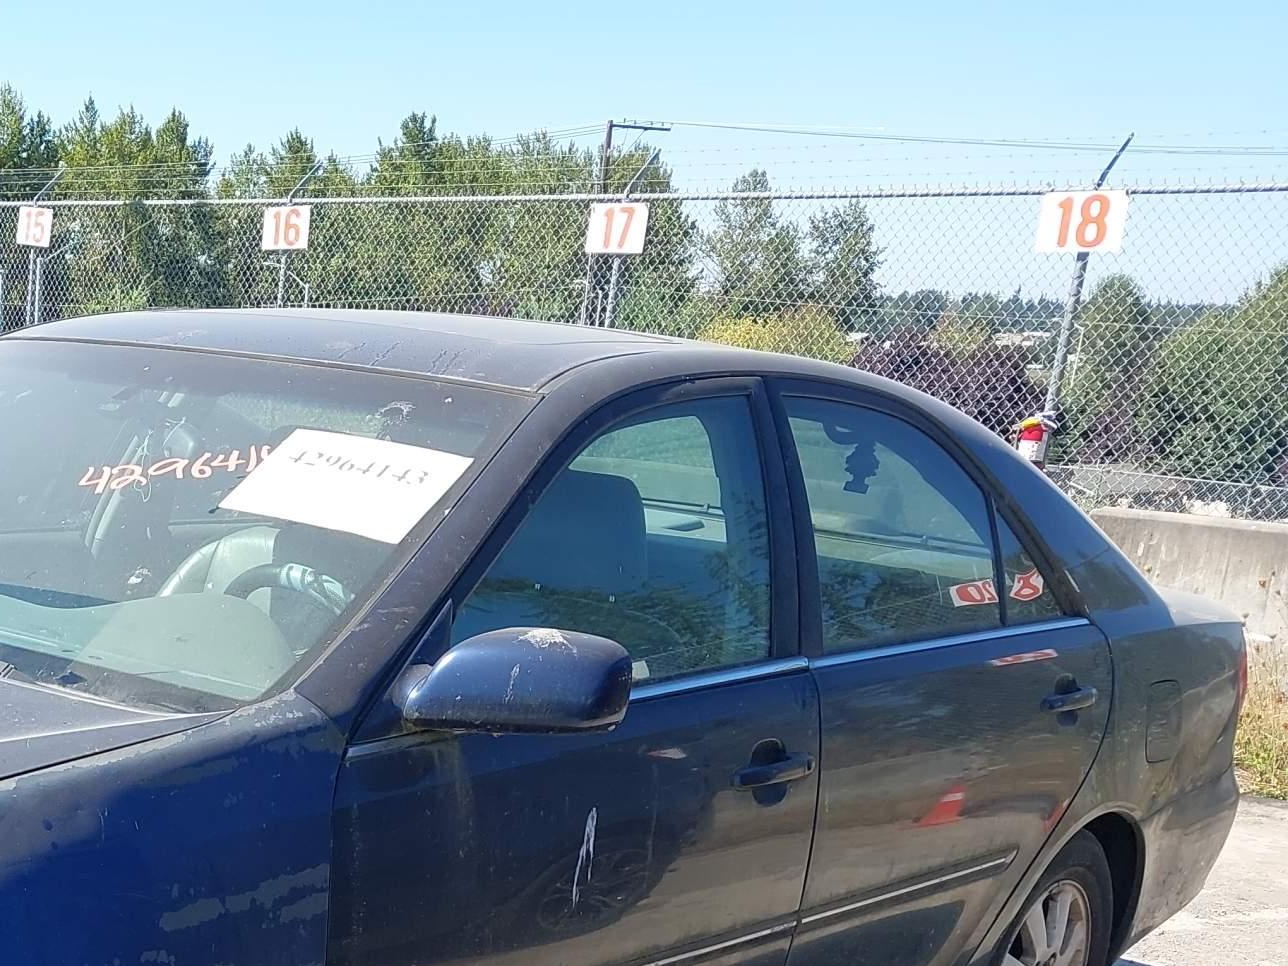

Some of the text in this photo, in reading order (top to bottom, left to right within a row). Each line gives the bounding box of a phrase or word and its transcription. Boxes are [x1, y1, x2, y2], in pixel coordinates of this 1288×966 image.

[25, 210, 46, 243] 15
[273, 208, 301, 247] 16
[602, 207, 636, 249] 17
[1057, 194, 1110, 248] 18
